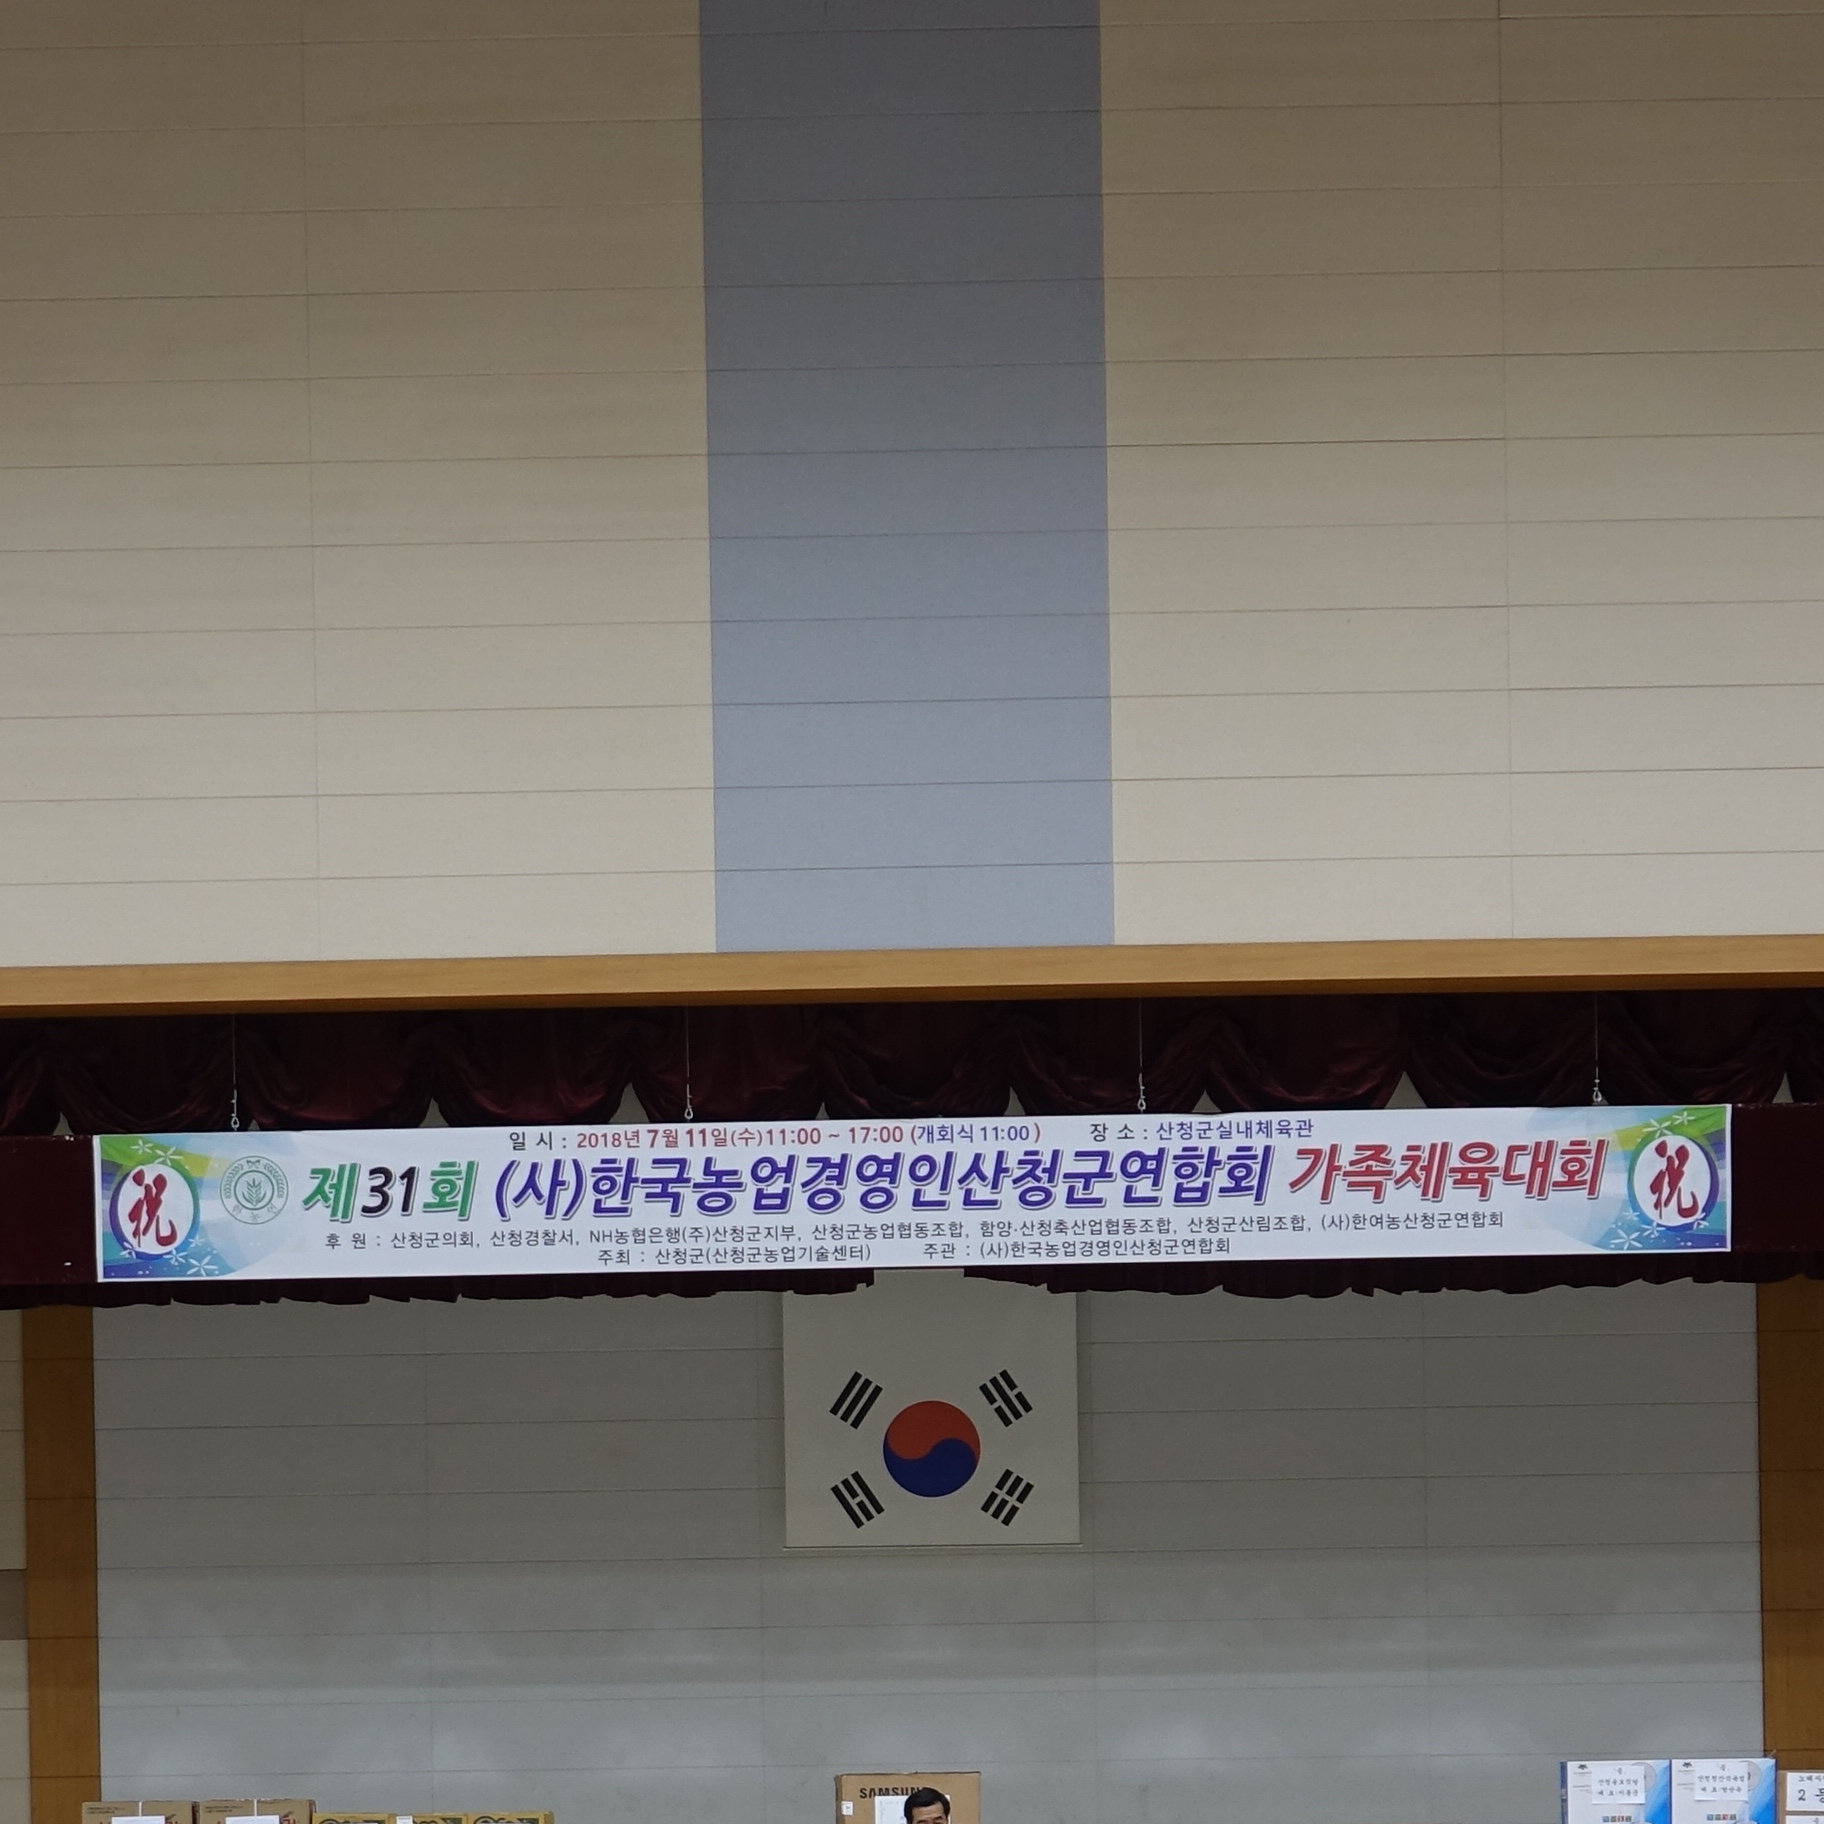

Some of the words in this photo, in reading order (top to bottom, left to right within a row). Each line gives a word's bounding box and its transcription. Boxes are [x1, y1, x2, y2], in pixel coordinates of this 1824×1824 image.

[576, 1130, 641, 1150] 2018년
[646, 1128, 679, 1149] 7월
[848, 1126, 905, 1144] 17:00
[1155, 1119, 1314, 1141] 산청군실내체육관
[302, 1160, 478, 1222] 제31회
[494, 1144, 1276, 1221] (사)한국농업경영인산청군연합회
[1288, 1137, 1608, 1204] 가족체육대회
[1651, 1141, 1701, 1219] 祝
[127, 1168, 179, 1248] 祝
[598, 1249, 631, 1266] 주최
[924, 1243, 957, 1260] 주관
[979, 1237, 1231, 1260] (사)한국농업경영인산청군연합회
